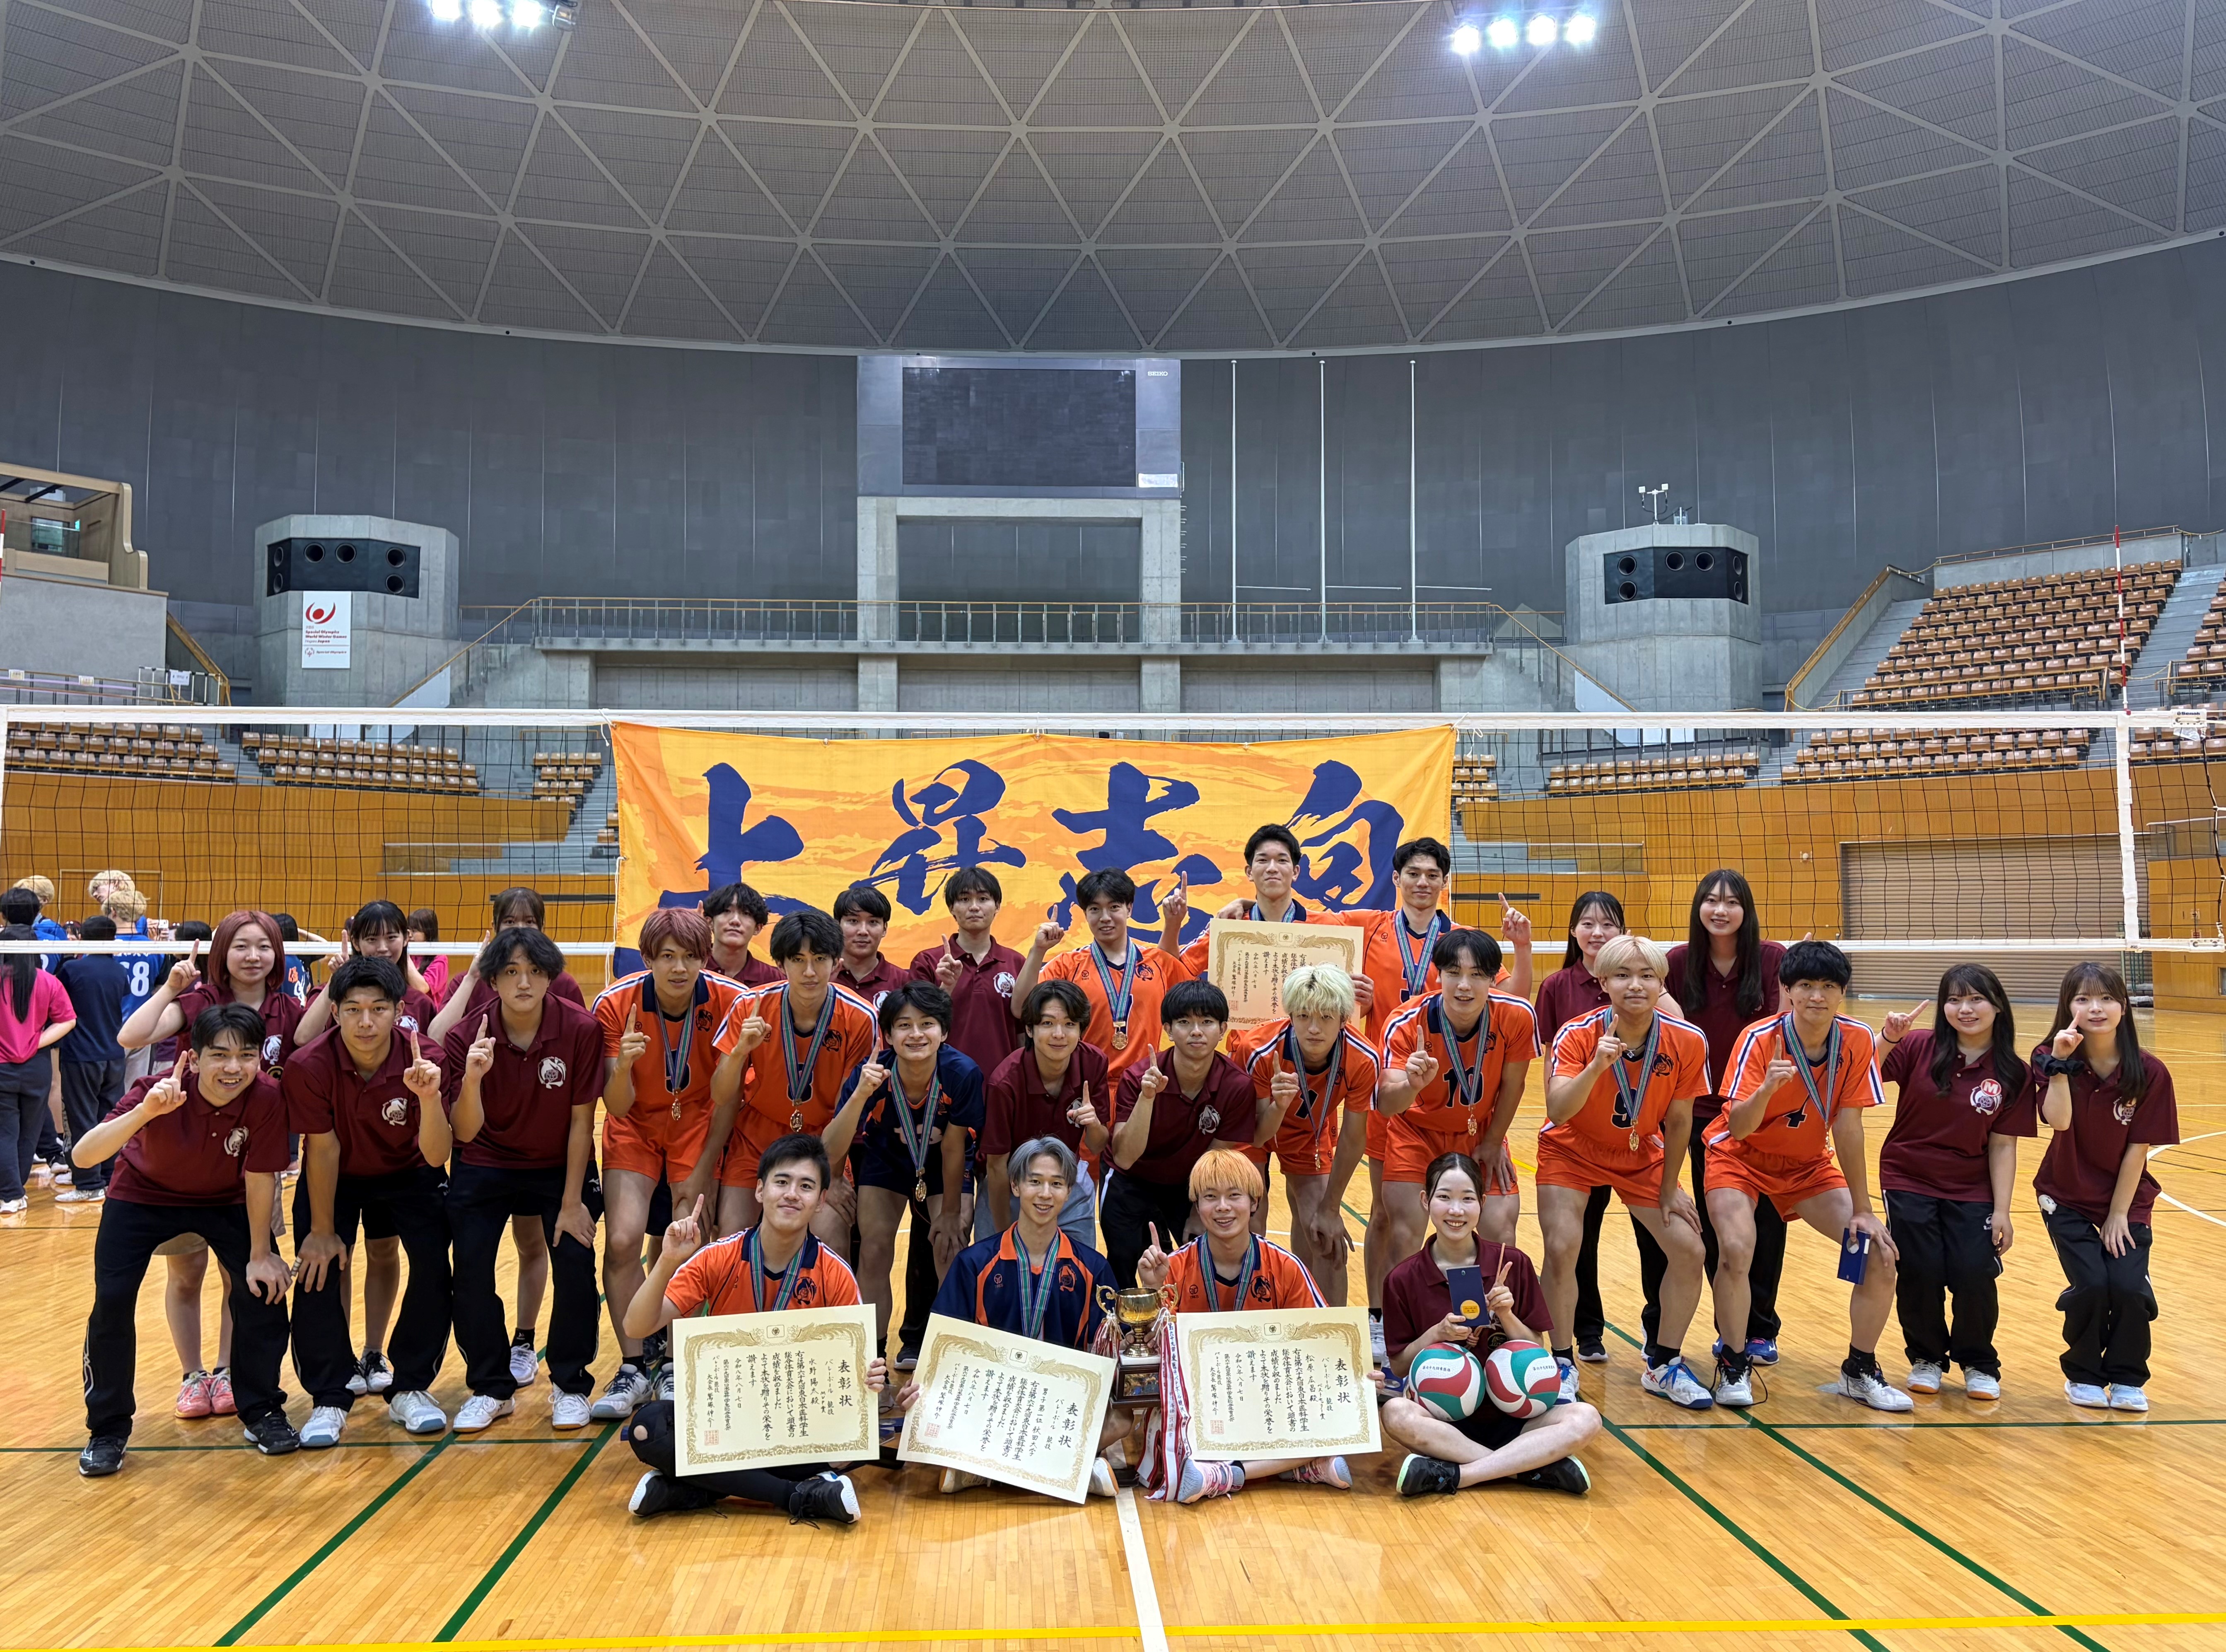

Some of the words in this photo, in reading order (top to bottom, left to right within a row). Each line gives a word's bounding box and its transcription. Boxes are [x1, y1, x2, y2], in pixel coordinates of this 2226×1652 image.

[658, 758, 1404, 944] 上昇志向
[1442, 1065, 1484, 1108] 10
[1610, 1087, 1639, 1129] 9
[1983, 1080, 1999, 1094] M
[773, 1353, 782, 1409] 成績を収めました
[825, 1359, 833, 1394] バレーボール
[838, 1360, 853, 1407] 表彰状
[1271, 1349, 1282, 1404] 成績を収めました
[1322, 1357, 1331, 1390] バレーボール
[1335, 1358, 1351, 1403] 表彰状
[1050, 1399, 1065, 1430] バレーボール
[1058, 1402, 1078, 1448] 表彰状
[1029, 1426, 1041, 1456] 秋田大学
